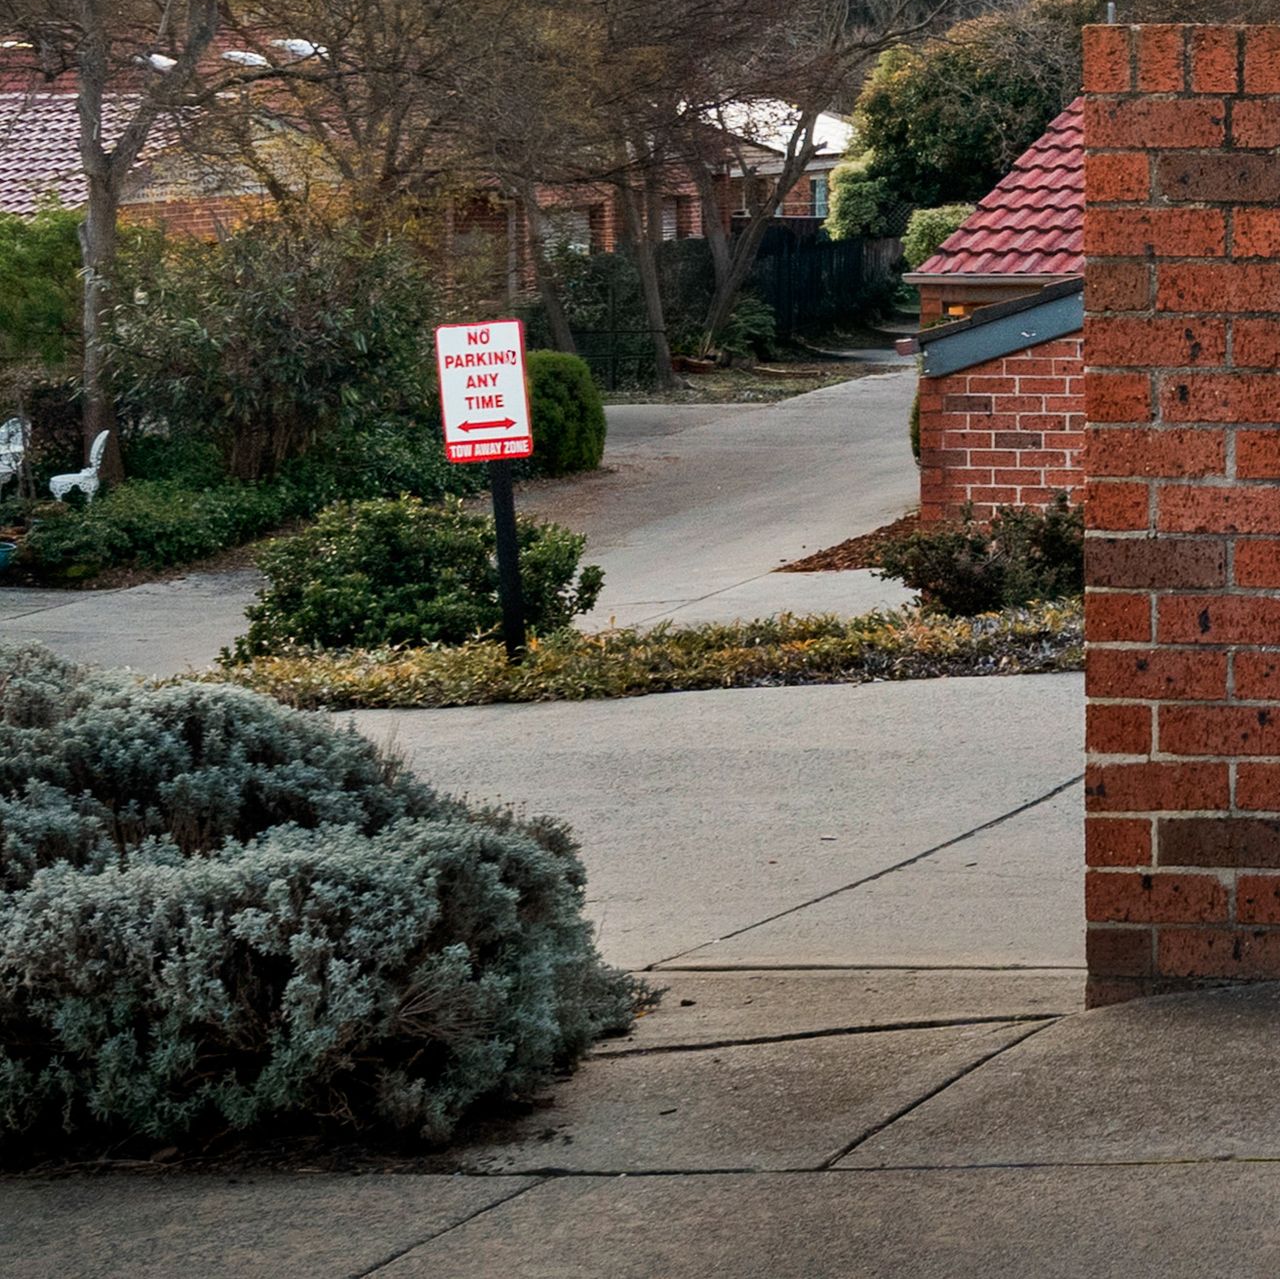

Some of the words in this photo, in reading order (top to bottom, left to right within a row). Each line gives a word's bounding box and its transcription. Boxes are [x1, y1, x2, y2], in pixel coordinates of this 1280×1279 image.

[467, 328, 490, 346] NO
[466, 373, 499, 389] ANY
[464, 394, 505, 410] TIME
[450, 444, 473, 458] TOW
[474, 442, 502, 457] AWAY
[504, 439, 529, 453] ZONE
